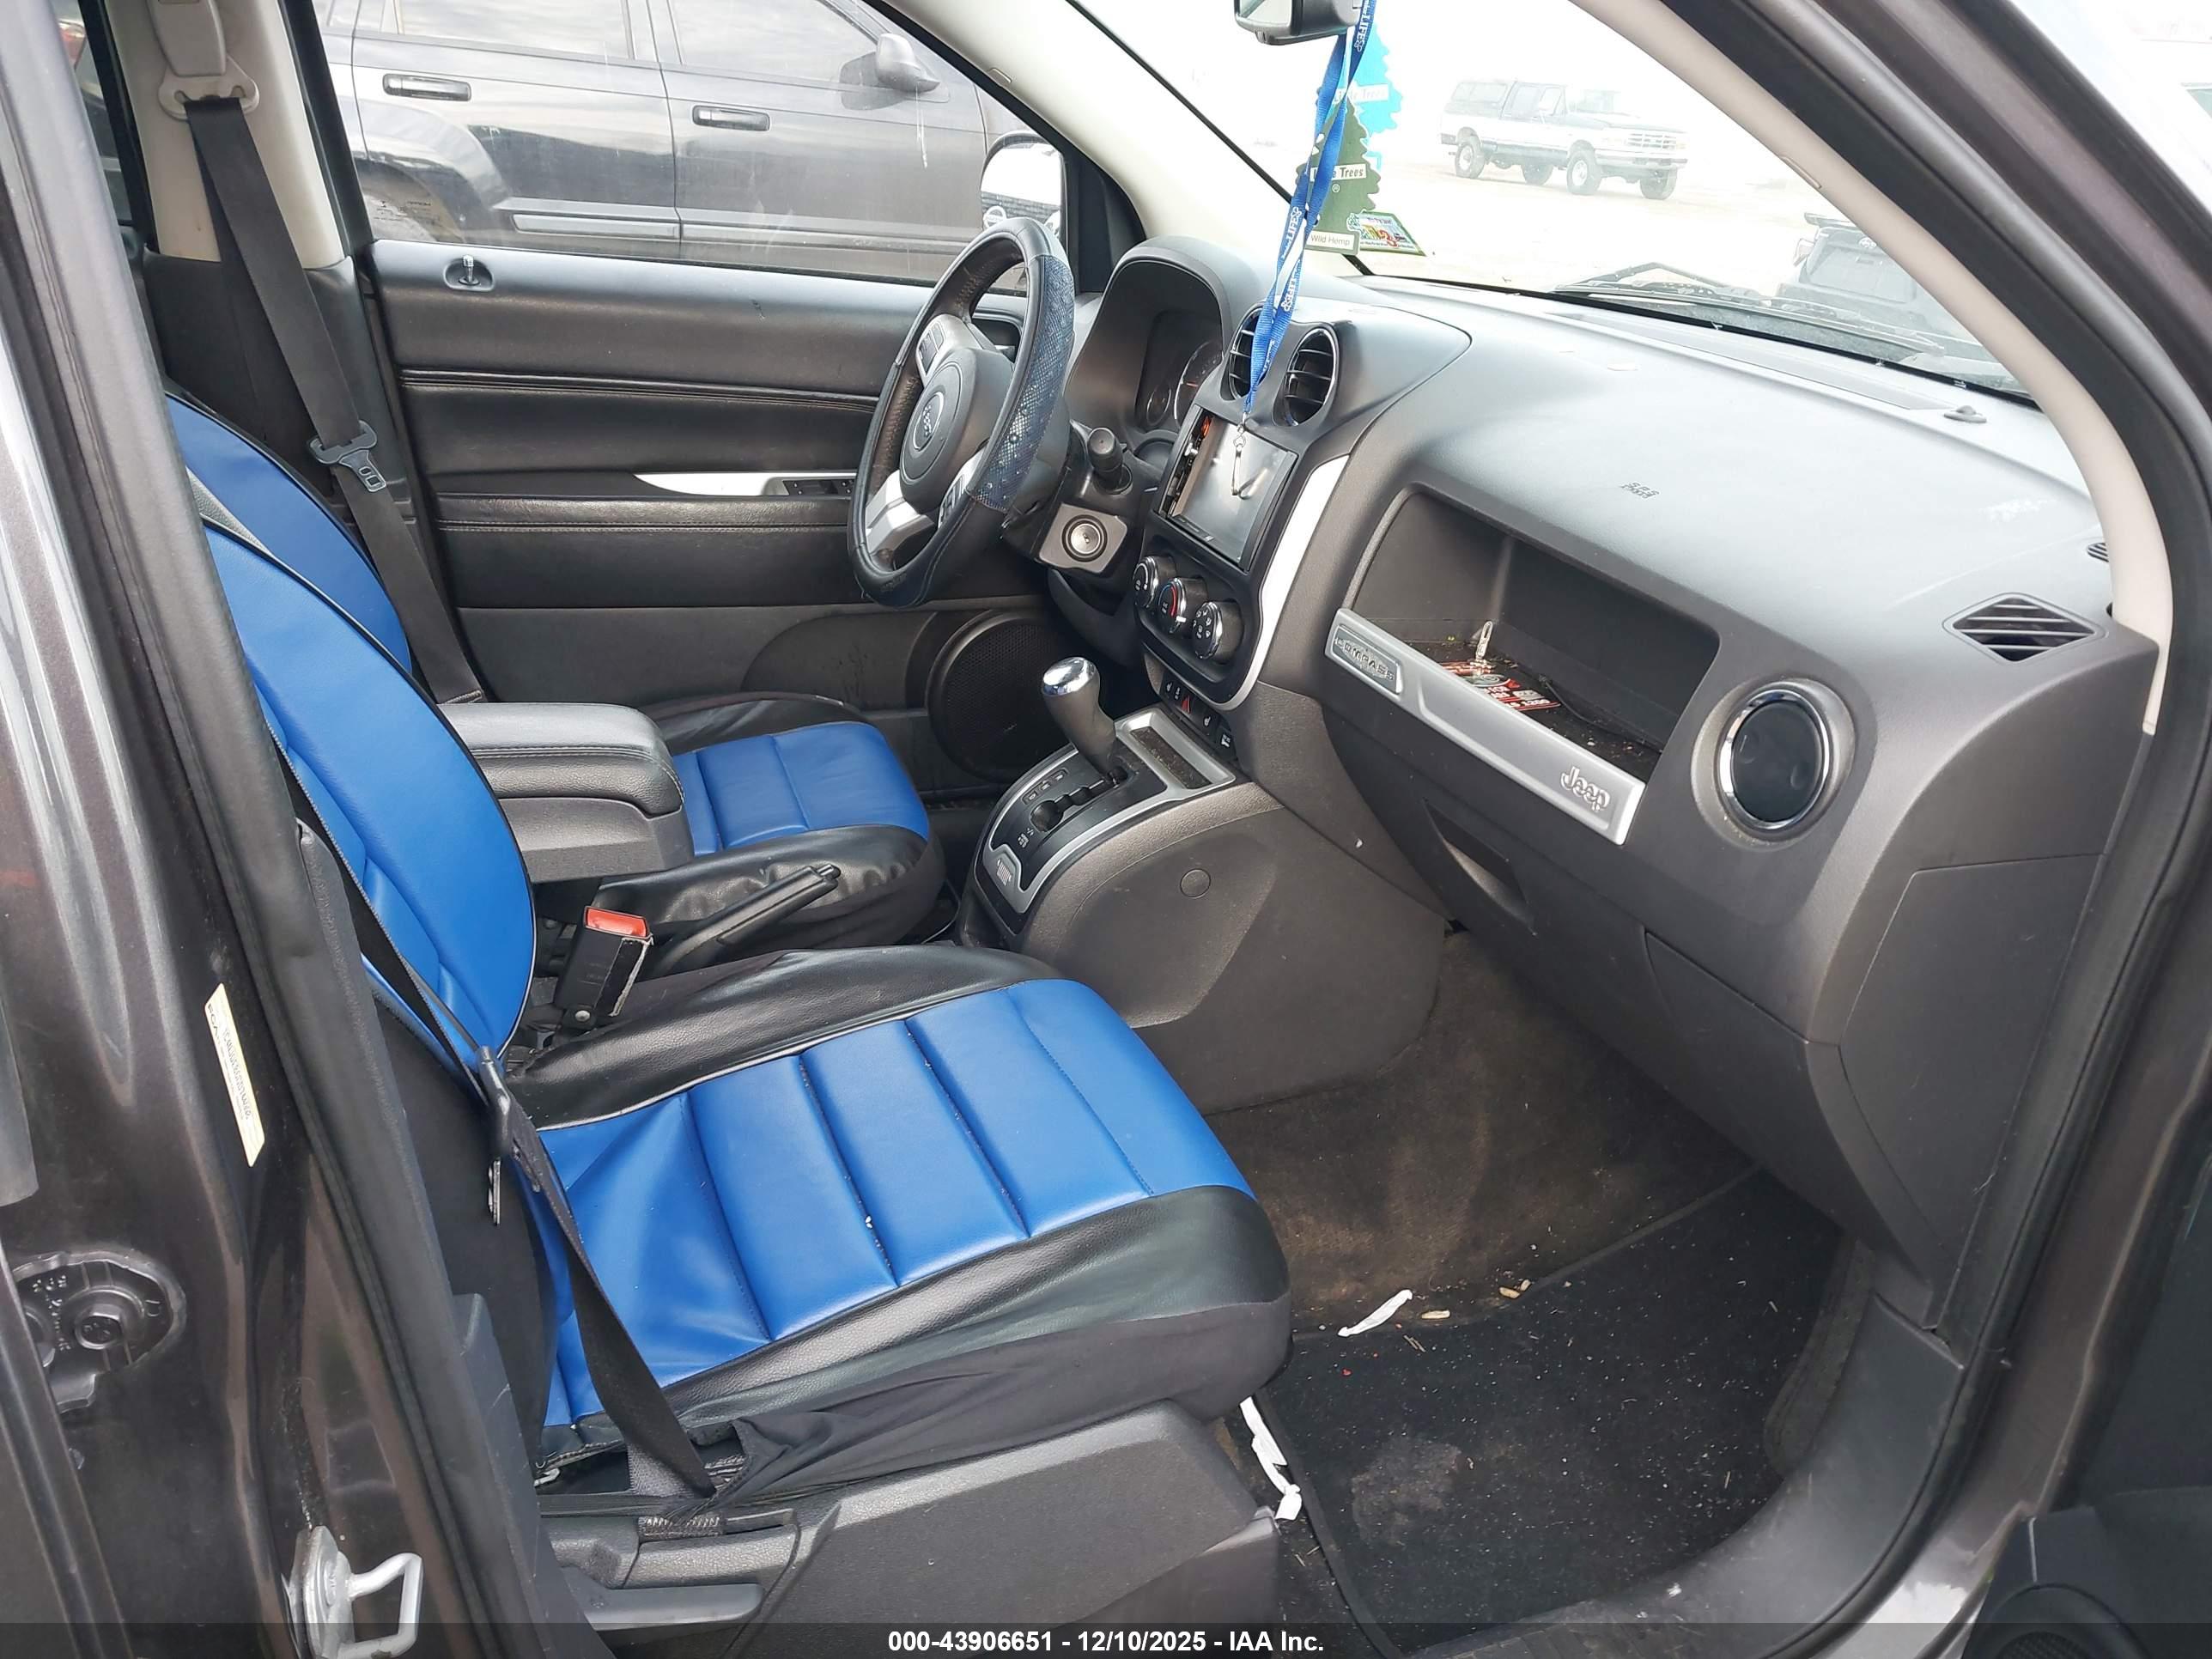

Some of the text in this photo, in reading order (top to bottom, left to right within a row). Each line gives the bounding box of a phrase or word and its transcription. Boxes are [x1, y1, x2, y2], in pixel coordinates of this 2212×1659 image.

[1340, 167, 1364, 178] Trees
[1311, 234, 1327, 243] Wild
[1329, 236, 1351, 246] Hemp
[1334, 637, 1395, 681] COMPASS
[1560, 766, 1610, 812] Jeep
